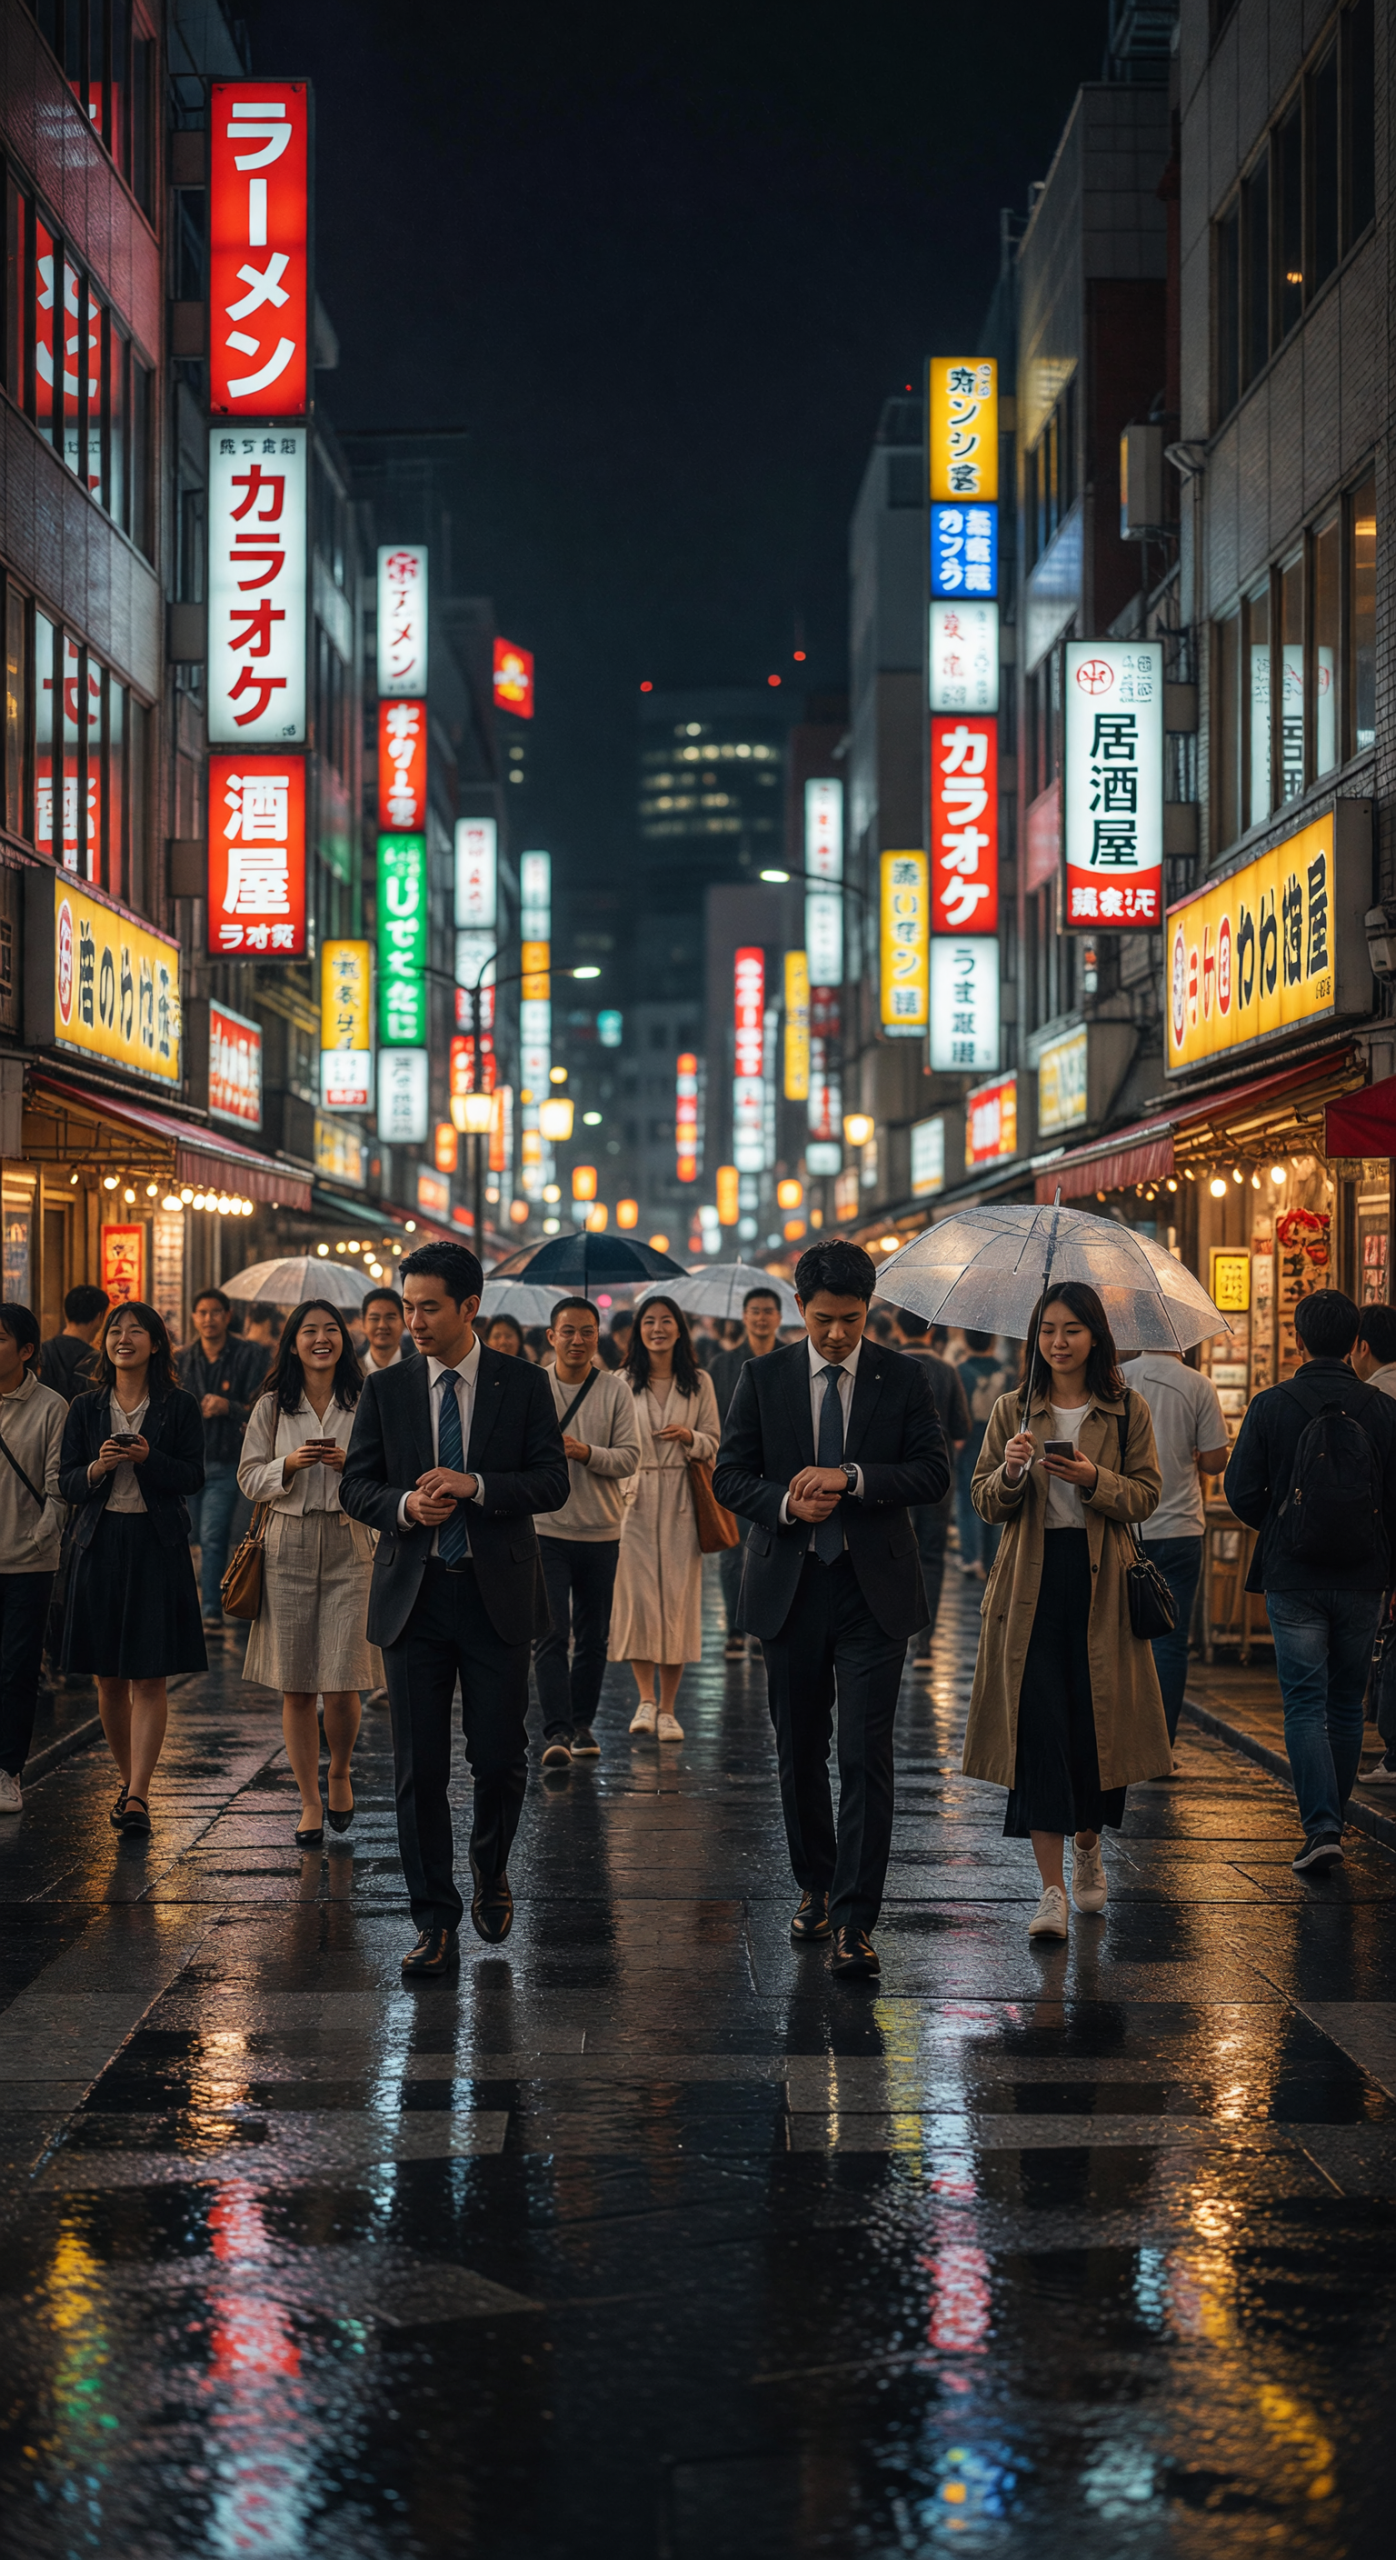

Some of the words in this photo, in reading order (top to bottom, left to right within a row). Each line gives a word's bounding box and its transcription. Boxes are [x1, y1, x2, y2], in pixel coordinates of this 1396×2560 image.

[225, 102, 296, 398] ラーメン
[227, 464, 287, 727] カラオケ
[222, 773, 291, 914] 酒屋
[939, 725, 990, 926] カラオケ
[1089, 713, 1139, 866] 居酒屋
